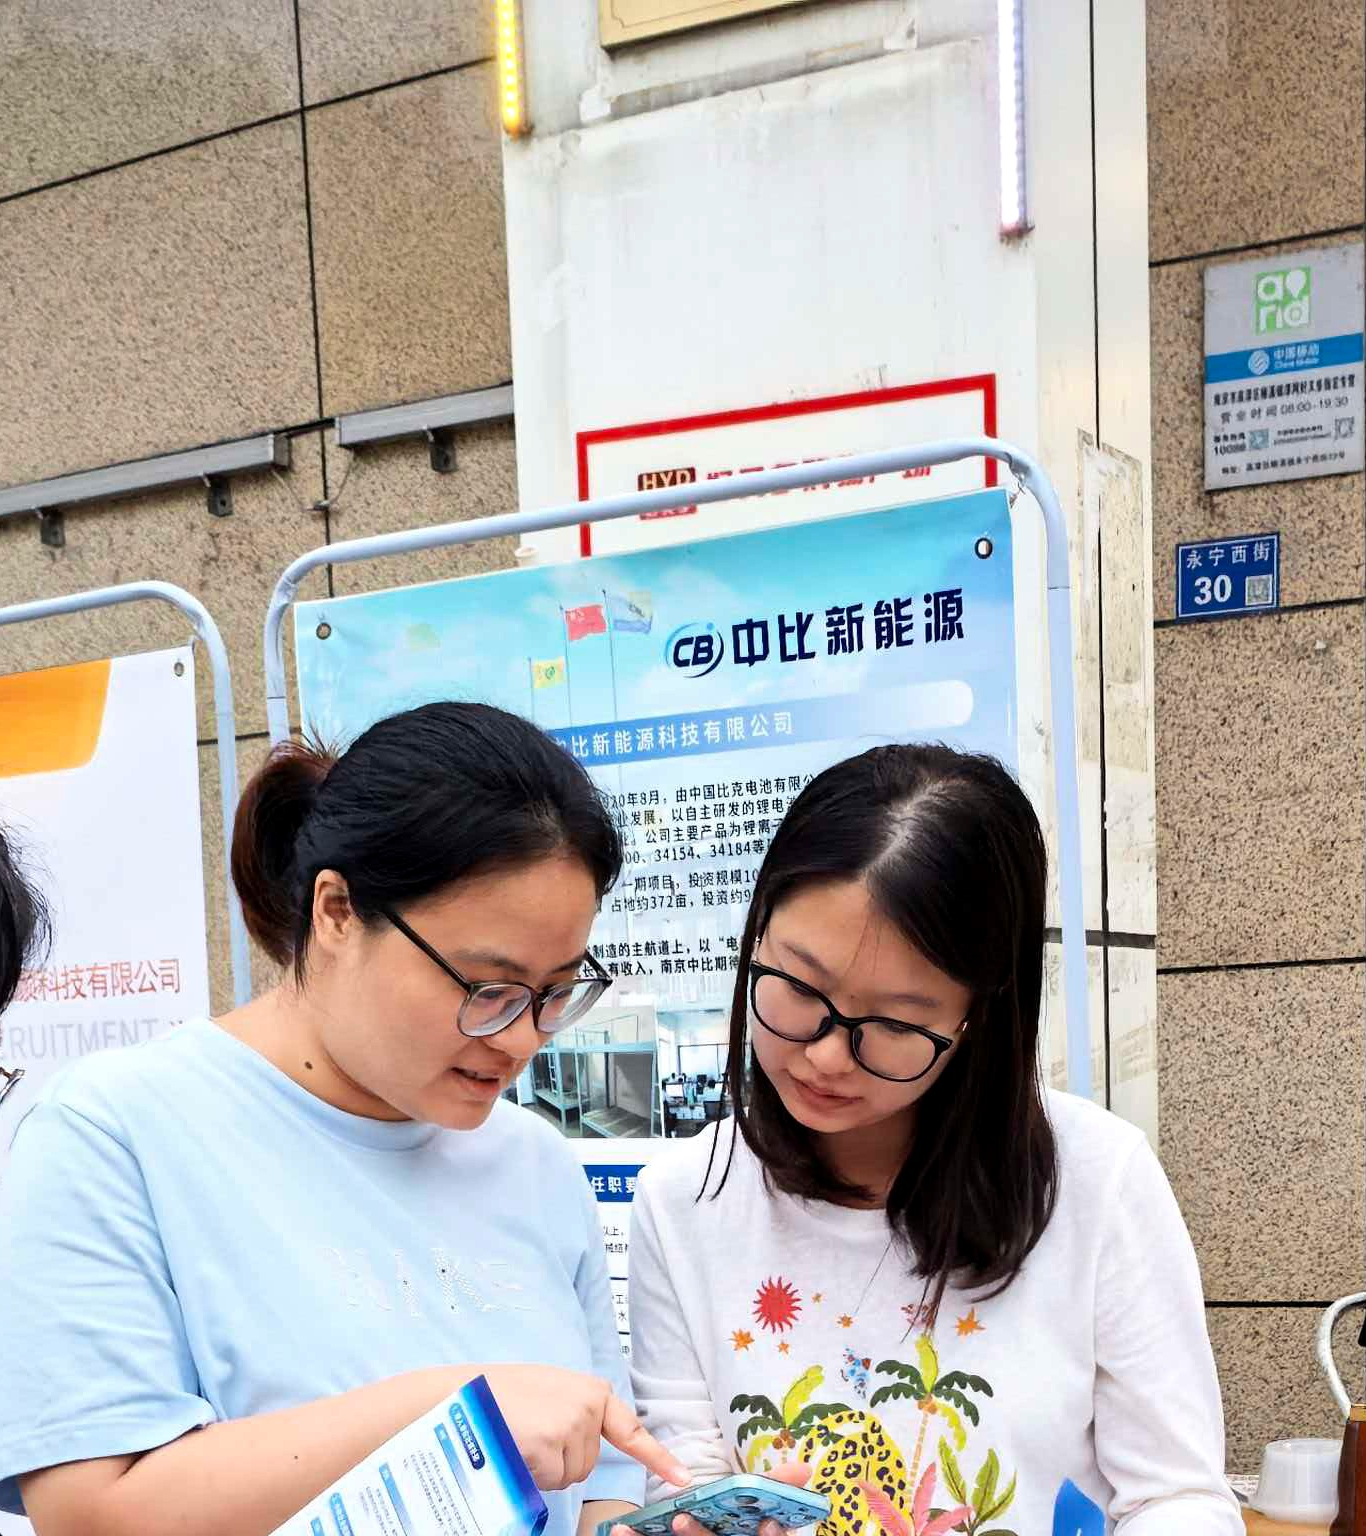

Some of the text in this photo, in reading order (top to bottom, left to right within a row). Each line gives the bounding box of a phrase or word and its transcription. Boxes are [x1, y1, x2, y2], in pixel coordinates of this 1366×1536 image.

[1186, 543, 1271, 570] 永宁西街
[1193, 574, 1233, 606] 30
[672, 588, 964, 668] CB 中比新能源
[554, 711, 793, 757] 比新能源科技有限公司
[588, 935, 740, 959] 制造的主航道上，以“电
